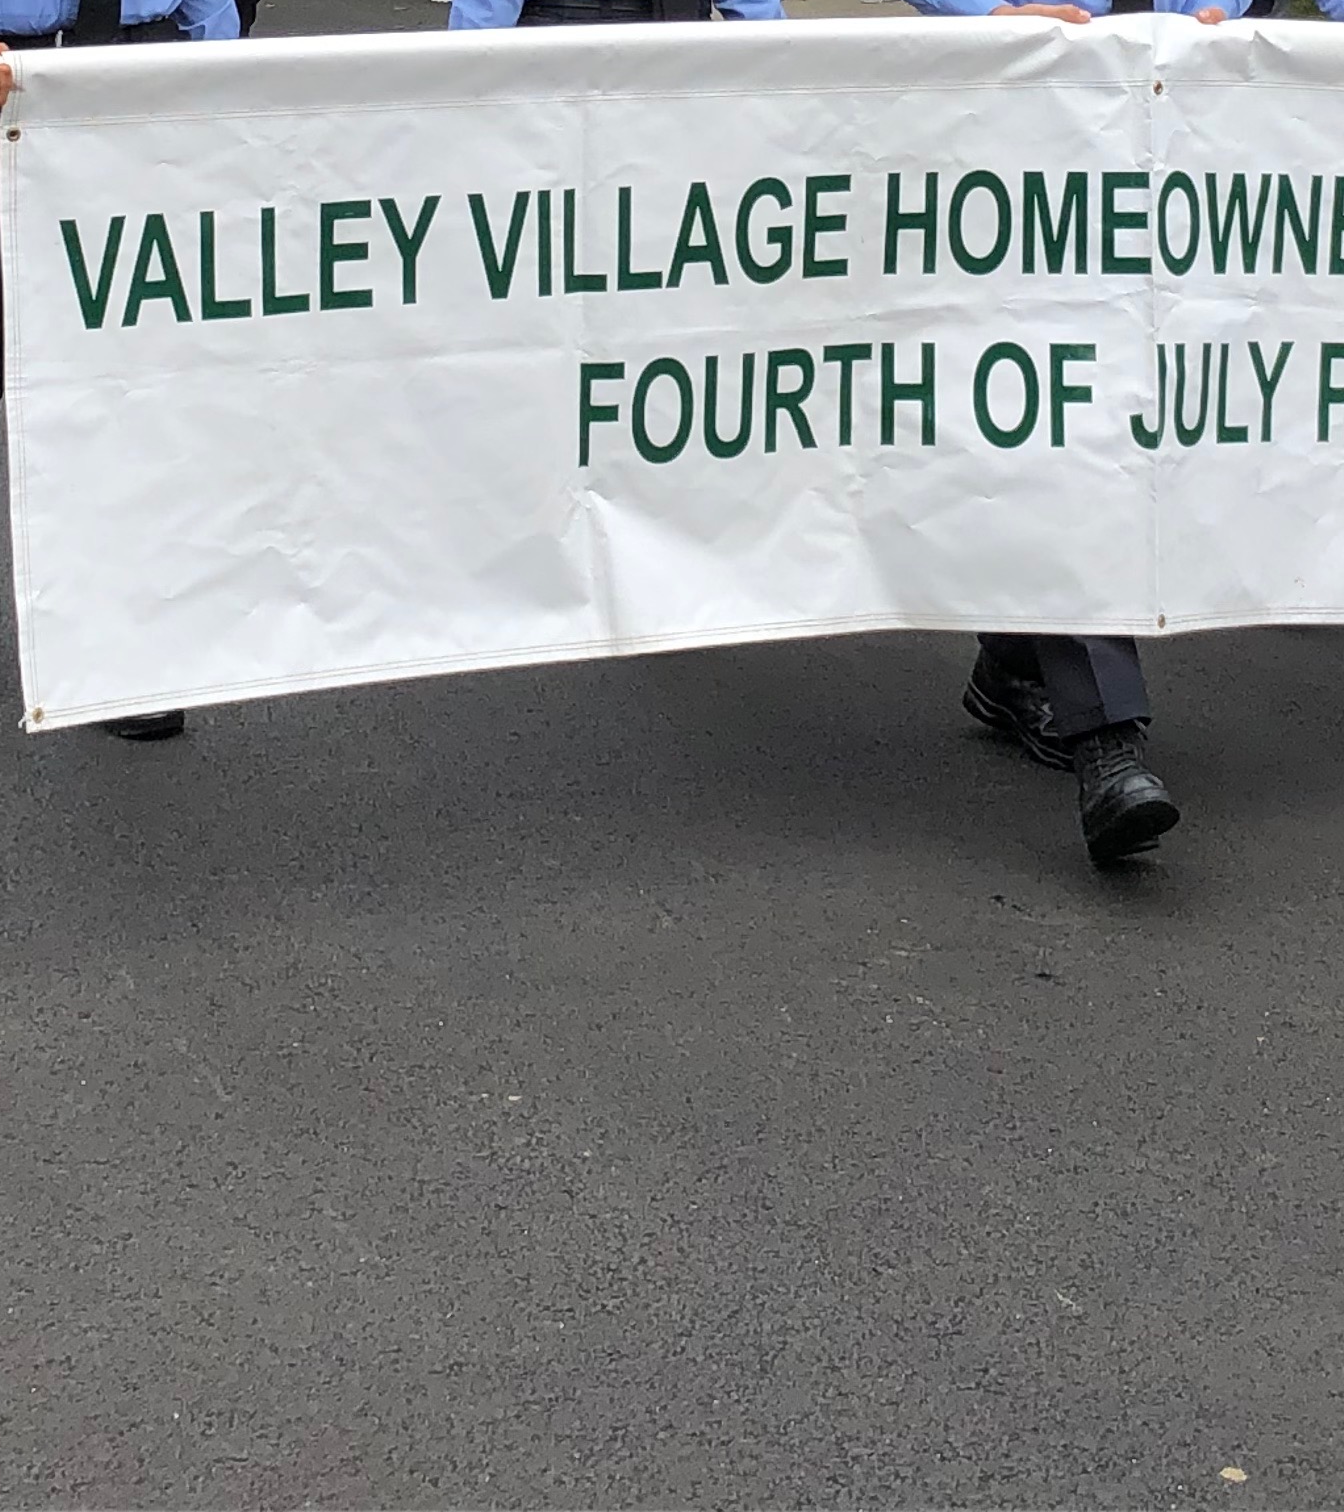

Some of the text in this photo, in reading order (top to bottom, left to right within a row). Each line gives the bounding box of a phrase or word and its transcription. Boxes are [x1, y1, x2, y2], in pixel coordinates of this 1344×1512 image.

[62, 197, 437, 330] VALLEY
[470, 175, 849, 300] VILLAGE
[580, 343, 936, 464] FOURTH
[974, 343, 1095, 449] OF
[1131, 343, 1292, 450] JULY
